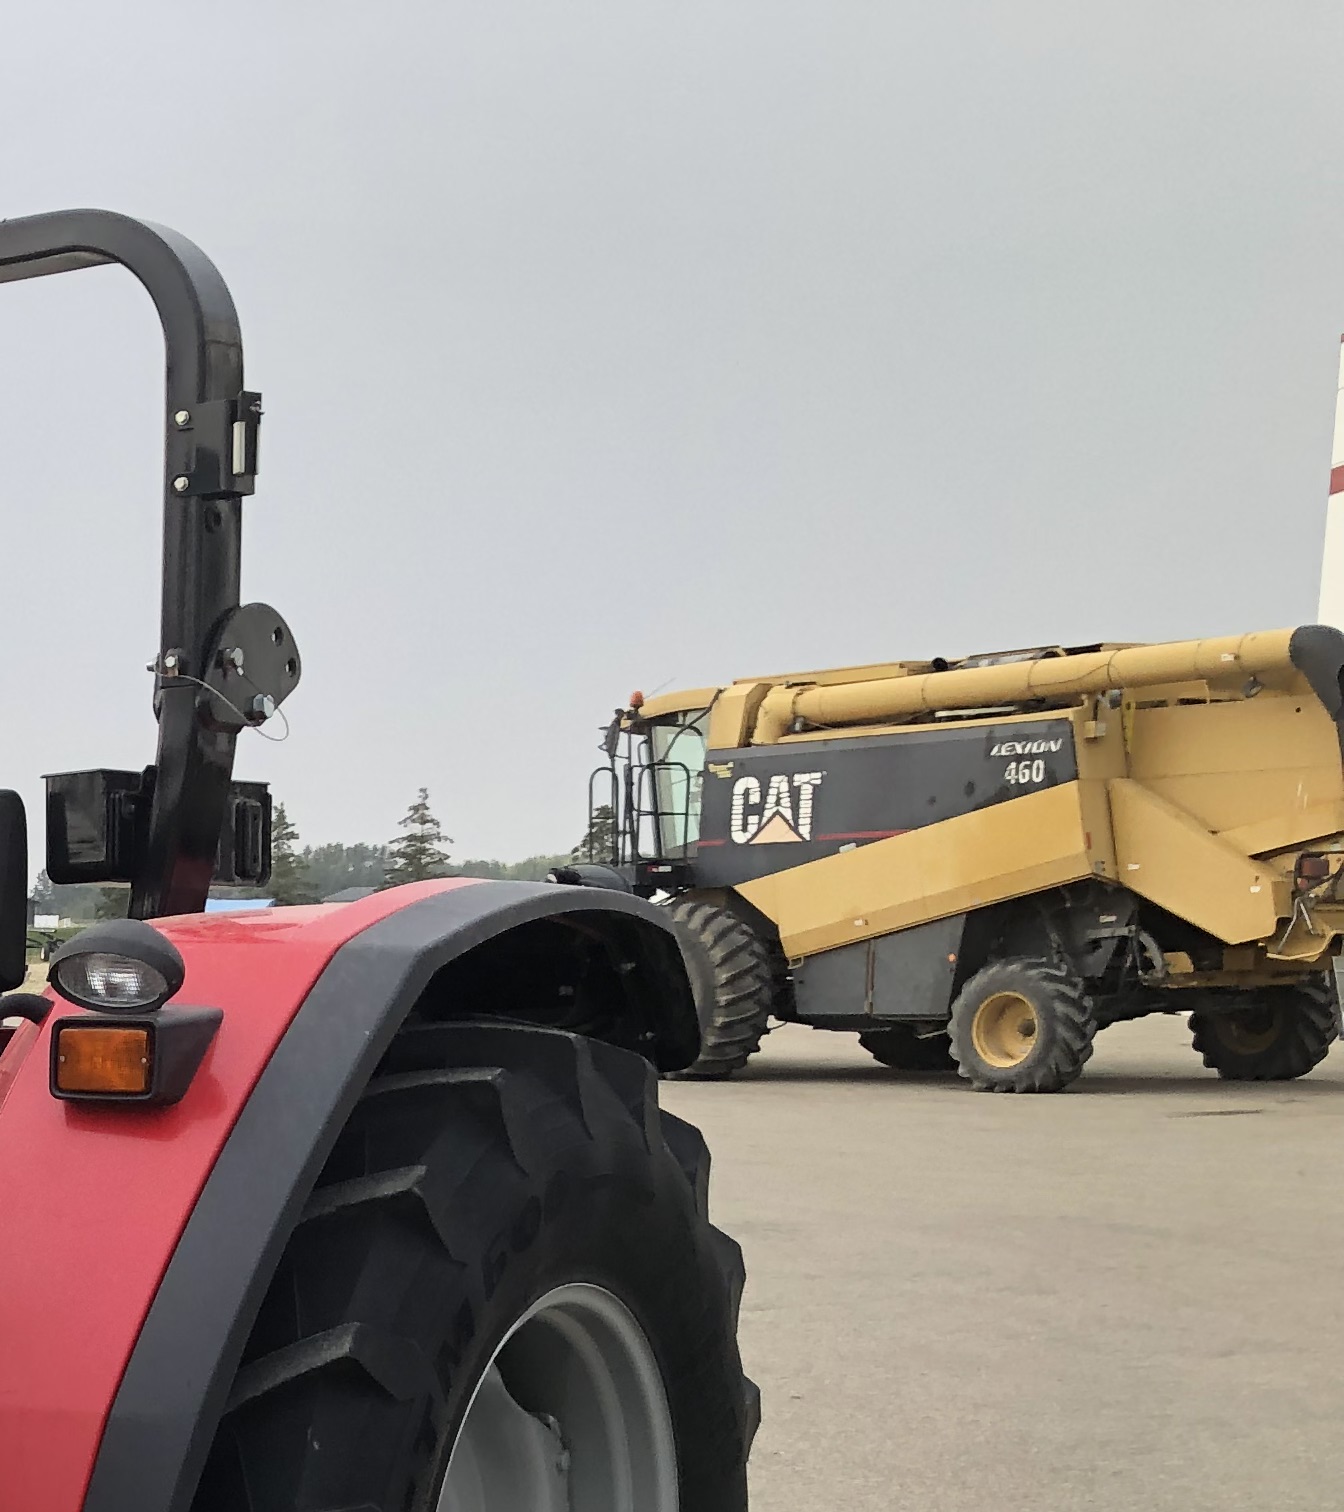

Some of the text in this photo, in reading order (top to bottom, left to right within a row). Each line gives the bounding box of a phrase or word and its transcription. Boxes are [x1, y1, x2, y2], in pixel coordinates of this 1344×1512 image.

[990, 737, 1063, 756] LEXION
[1004, 759, 1046, 785] 460
[730, 771, 823, 845] CAT
